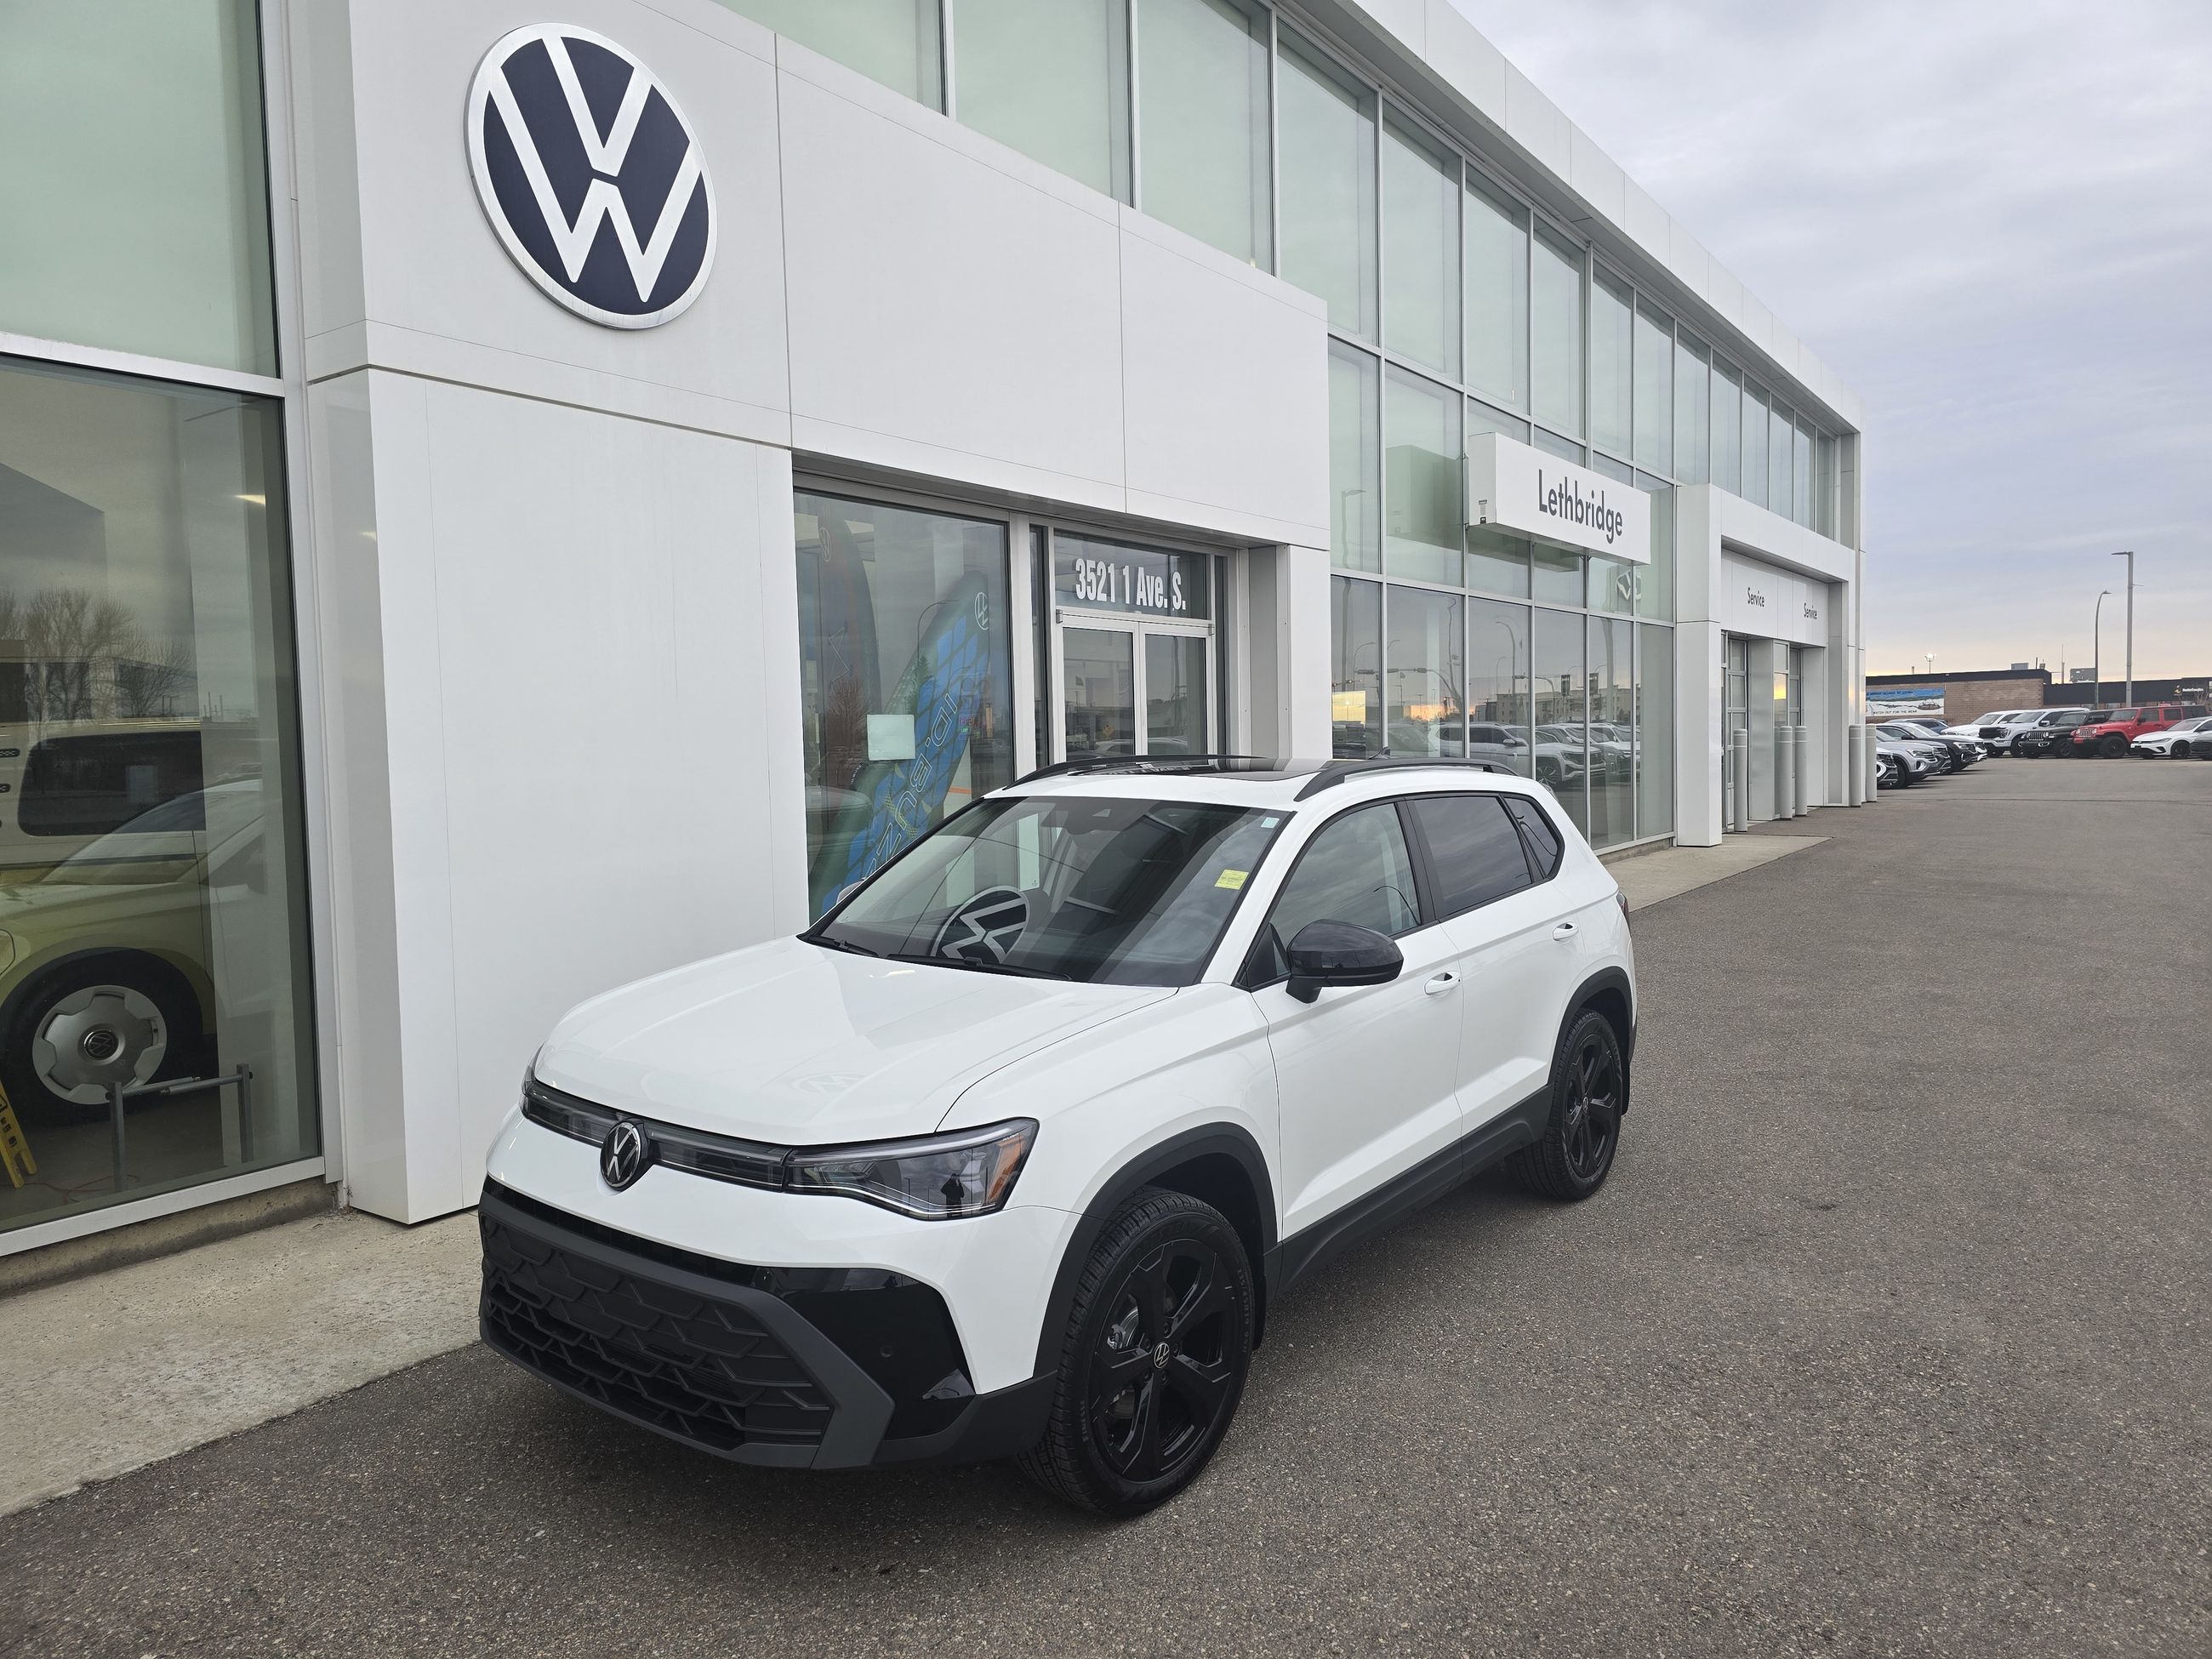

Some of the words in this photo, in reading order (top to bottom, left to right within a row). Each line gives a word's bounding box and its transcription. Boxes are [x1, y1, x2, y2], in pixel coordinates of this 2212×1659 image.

[1538, 469, 1623, 544] Lethbridge
[1075, 557, 1116, 603] 3521
[1122, 565, 1131, 605] 1
[1136, 566, 1168, 609] Ave.
[1172, 571, 1187, 610] S.
[1747, 586, 1765, 607] Service
[1803, 601, 1817, 619] Service
